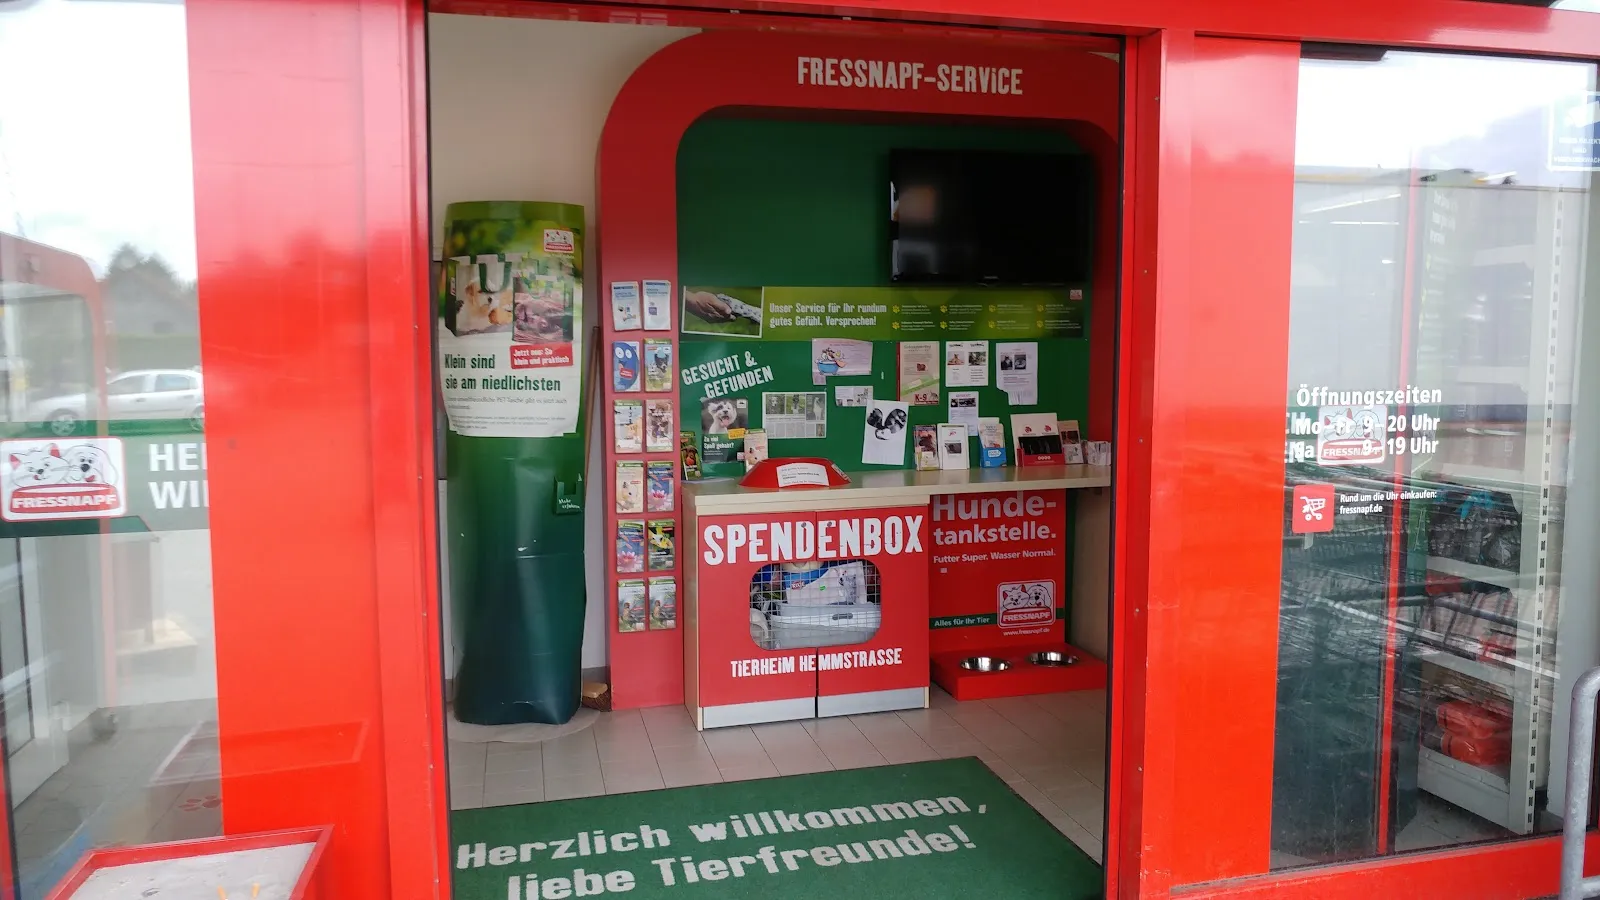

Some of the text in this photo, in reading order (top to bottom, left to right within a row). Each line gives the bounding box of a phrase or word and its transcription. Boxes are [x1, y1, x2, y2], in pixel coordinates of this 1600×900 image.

[769, 303, 887, 313] Unser Service für Ihr rundum
[769, 316, 877, 328] gutes Gefühl. Versprochen!
[444, 354, 496, 369] Klein sind
[680, 350, 758, 386] GESUCHT &
[445, 374, 561, 391] sie am niedlichsten
[704, 365, 774, 399] GEFUNDEN
[1296, 383, 1442, 409] Öffnungszeiten
[1411, 413, 1441, 431] Uhr
[1410, 435, 1439, 454] Uhr
[12, 493, 117, 509] FRESSNAPF
[1340, 489, 1437, 503] Rund um die Uhr einkaufen:
[933, 490, 1057, 521] Hunde-
[1340, 504, 1383, 515] fressnapf.de
[703, 515, 924, 566] SPENDENBOX
[933, 520, 1057, 546] tankstelle.
[933, 548, 1056, 563] Futter Super. Wasser Normal.
[934, 616, 991, 627] Alles für Ihr Tier
[1002, 611, 1051, 622] FRESSNAPF
[1003, 628, 1050, 636] www.fressnapf.de
[799, 647, 903, 672] HEMMSTRASSE
[456, 824, 671, 870] Herzlich
[507, 824, 977, 900] liebe Tierfreunde!
